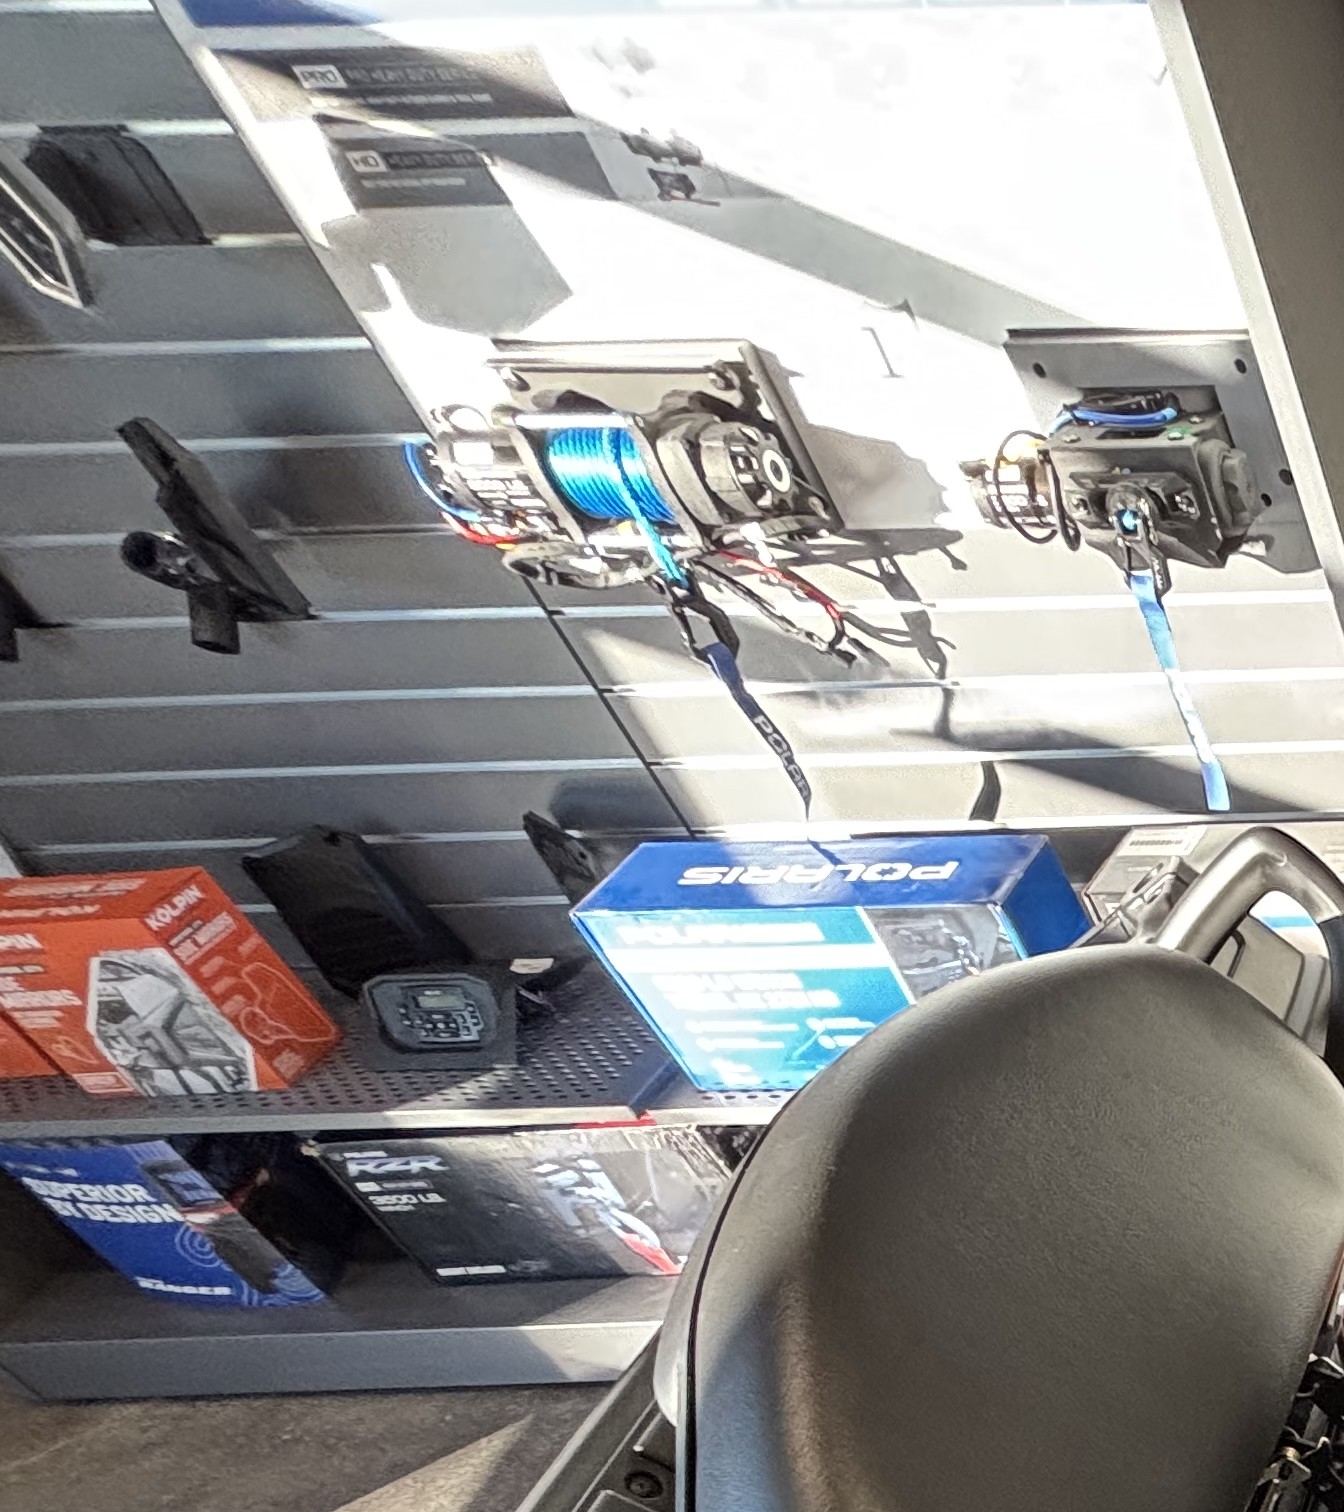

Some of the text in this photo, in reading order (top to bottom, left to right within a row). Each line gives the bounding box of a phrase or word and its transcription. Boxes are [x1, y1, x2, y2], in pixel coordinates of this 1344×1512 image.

[678, 860, 960, 886] POLARIS
[144, 883, 205, 931] KOLPIN
[346, 1155, 449, 1176] RZR
[22, 1176, 158, 1203] SUPERIOR
[42, 1198, 187, 1224] BY DESIGN
